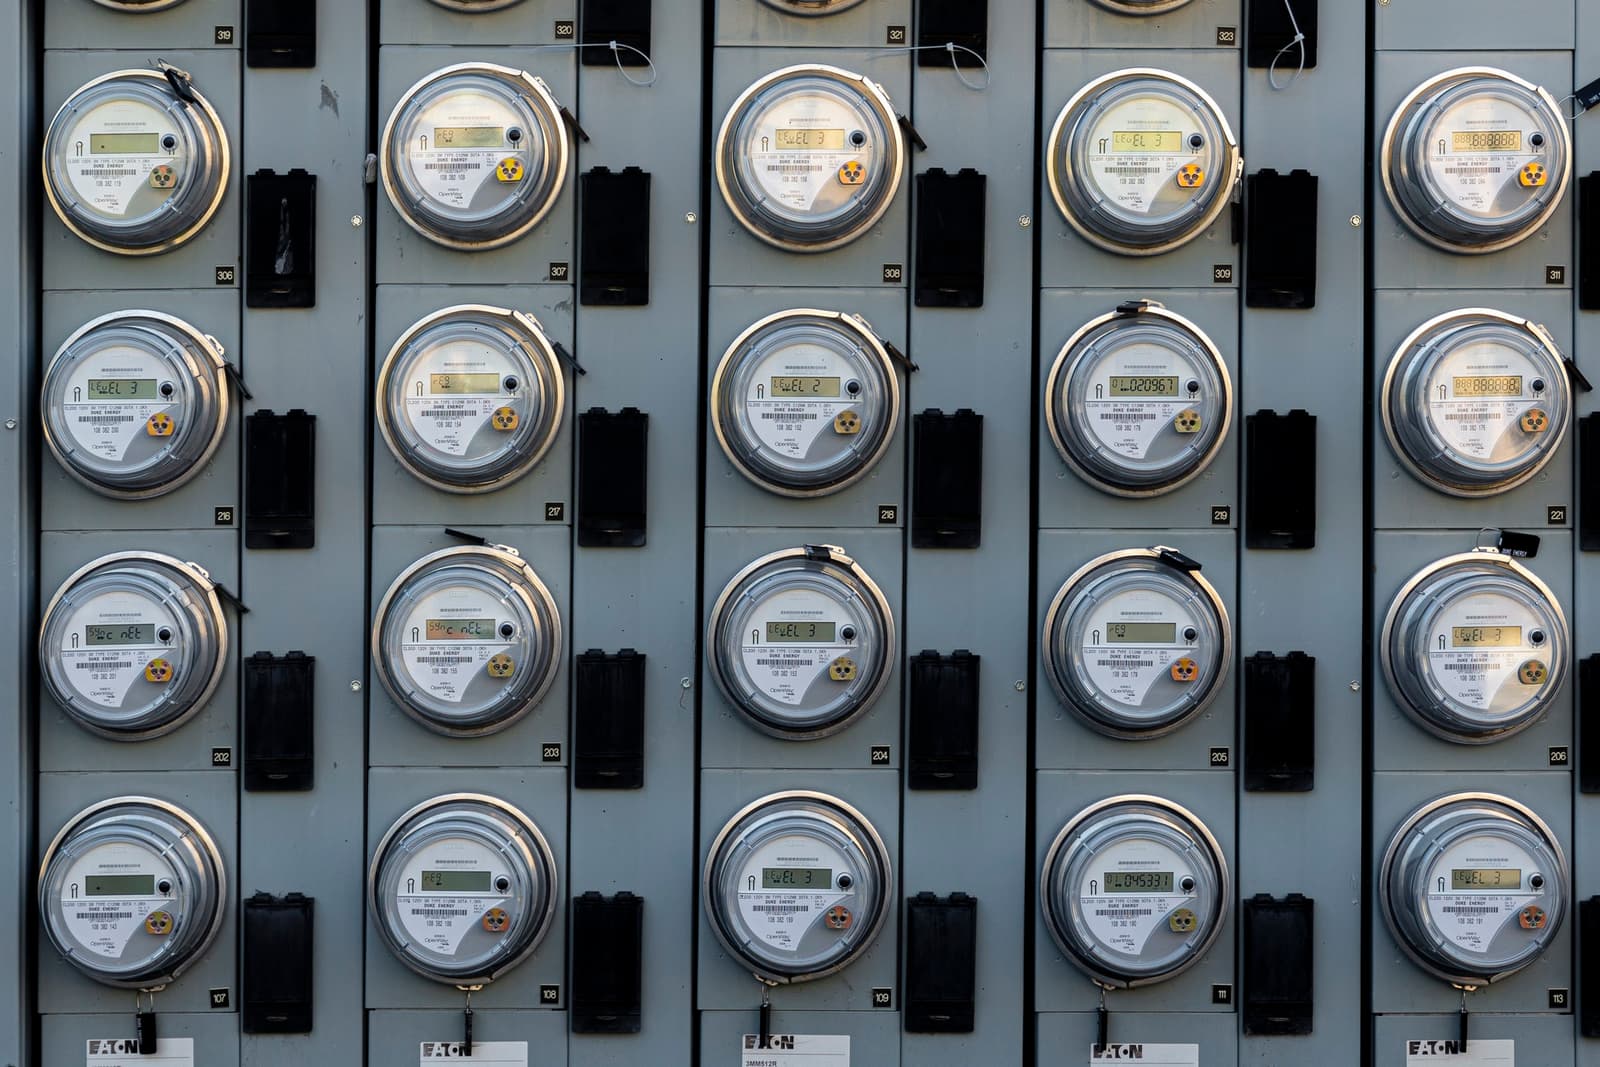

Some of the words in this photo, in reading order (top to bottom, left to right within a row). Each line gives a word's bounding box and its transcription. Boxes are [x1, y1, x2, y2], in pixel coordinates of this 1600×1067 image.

[217, 30, 231, 40] 319
[556, 25, 573, 35] 320
[889, 29, 903, 40] 321
[1218, 31, 1234, 42] 323
[818, 132, 824, 144] 3
[1155, 134, 1161, 146] 3
[217, 270, 233, 281] 306
[551, 266, 567, 277] 307
[884, 268, 901, 279] 308
[1214, 268, 1231, 279] 309
[1549, 270, 1561, 280] 311
[131, 382, 137, 394] 3
[813, 379, 820, 392] 2
[217, 511, 231, 521] 216
[548, 506, 561, 517] 217
[881, 509, 895, 520] 218
[1214, 510, 1228, 521] 219
[1550, 510, 1564, 520] 221
[809, 624, 816, 637] 3
[1495, 628, 1501, 641] 3
[213, 752, 230, 762] 202
[543, 747, 560, 758] 203
[872, 750, 888, 761] 204
[1211, 752, 1228, 762] 205
[1550, 751, 1567, 761] 206
[805, 871, 812, 884] 3
[1494, 871, 1501, 884] 3
[213, 993, 226, 1003] 107
[543, 989, 557, 1000] 108
[875, 993, 889, 1003] 109
[1218, 990, 1227, 999] 111
[1553, 993, 1564, 1004] 113
[89, 1040, 138, 1055] EATON
[1409, 1040, 1459, 1055] EATON
